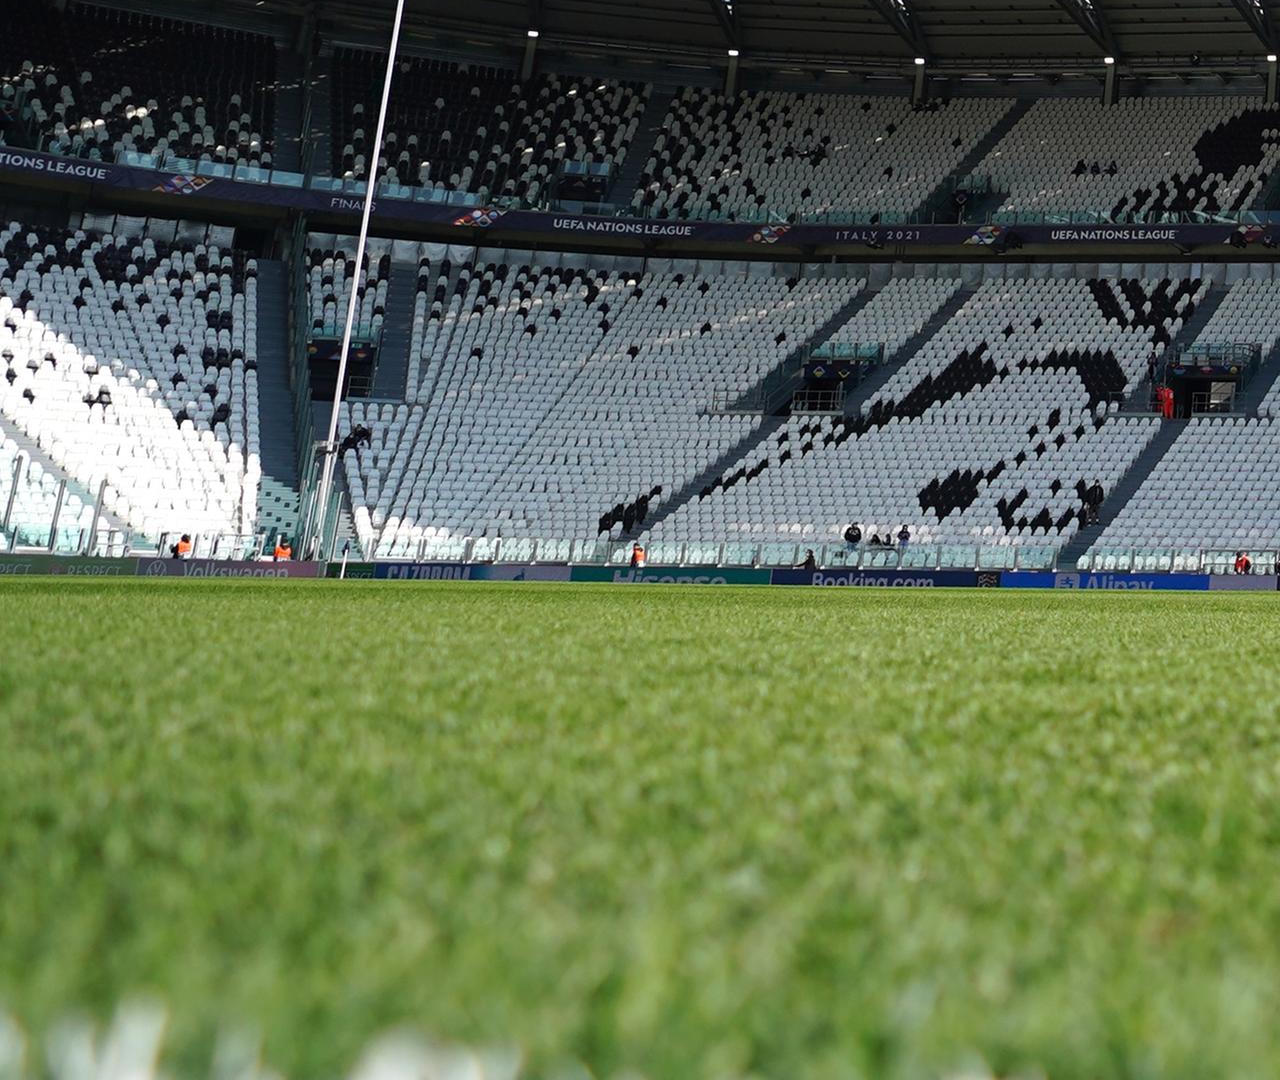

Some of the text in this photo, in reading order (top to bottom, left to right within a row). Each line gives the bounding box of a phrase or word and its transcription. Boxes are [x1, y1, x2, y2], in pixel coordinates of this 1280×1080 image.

[47, 160, 106, 179] LEAGUE
[553, 218, 692, 236] UEFA NATIONS LEAGUE
[835, 230, 921, 241] ITALY 2021
[1051, 230, 1175, 240] UEFA NATIONS LEAGUE
[183, 562, 289, 577] Volkswagen
